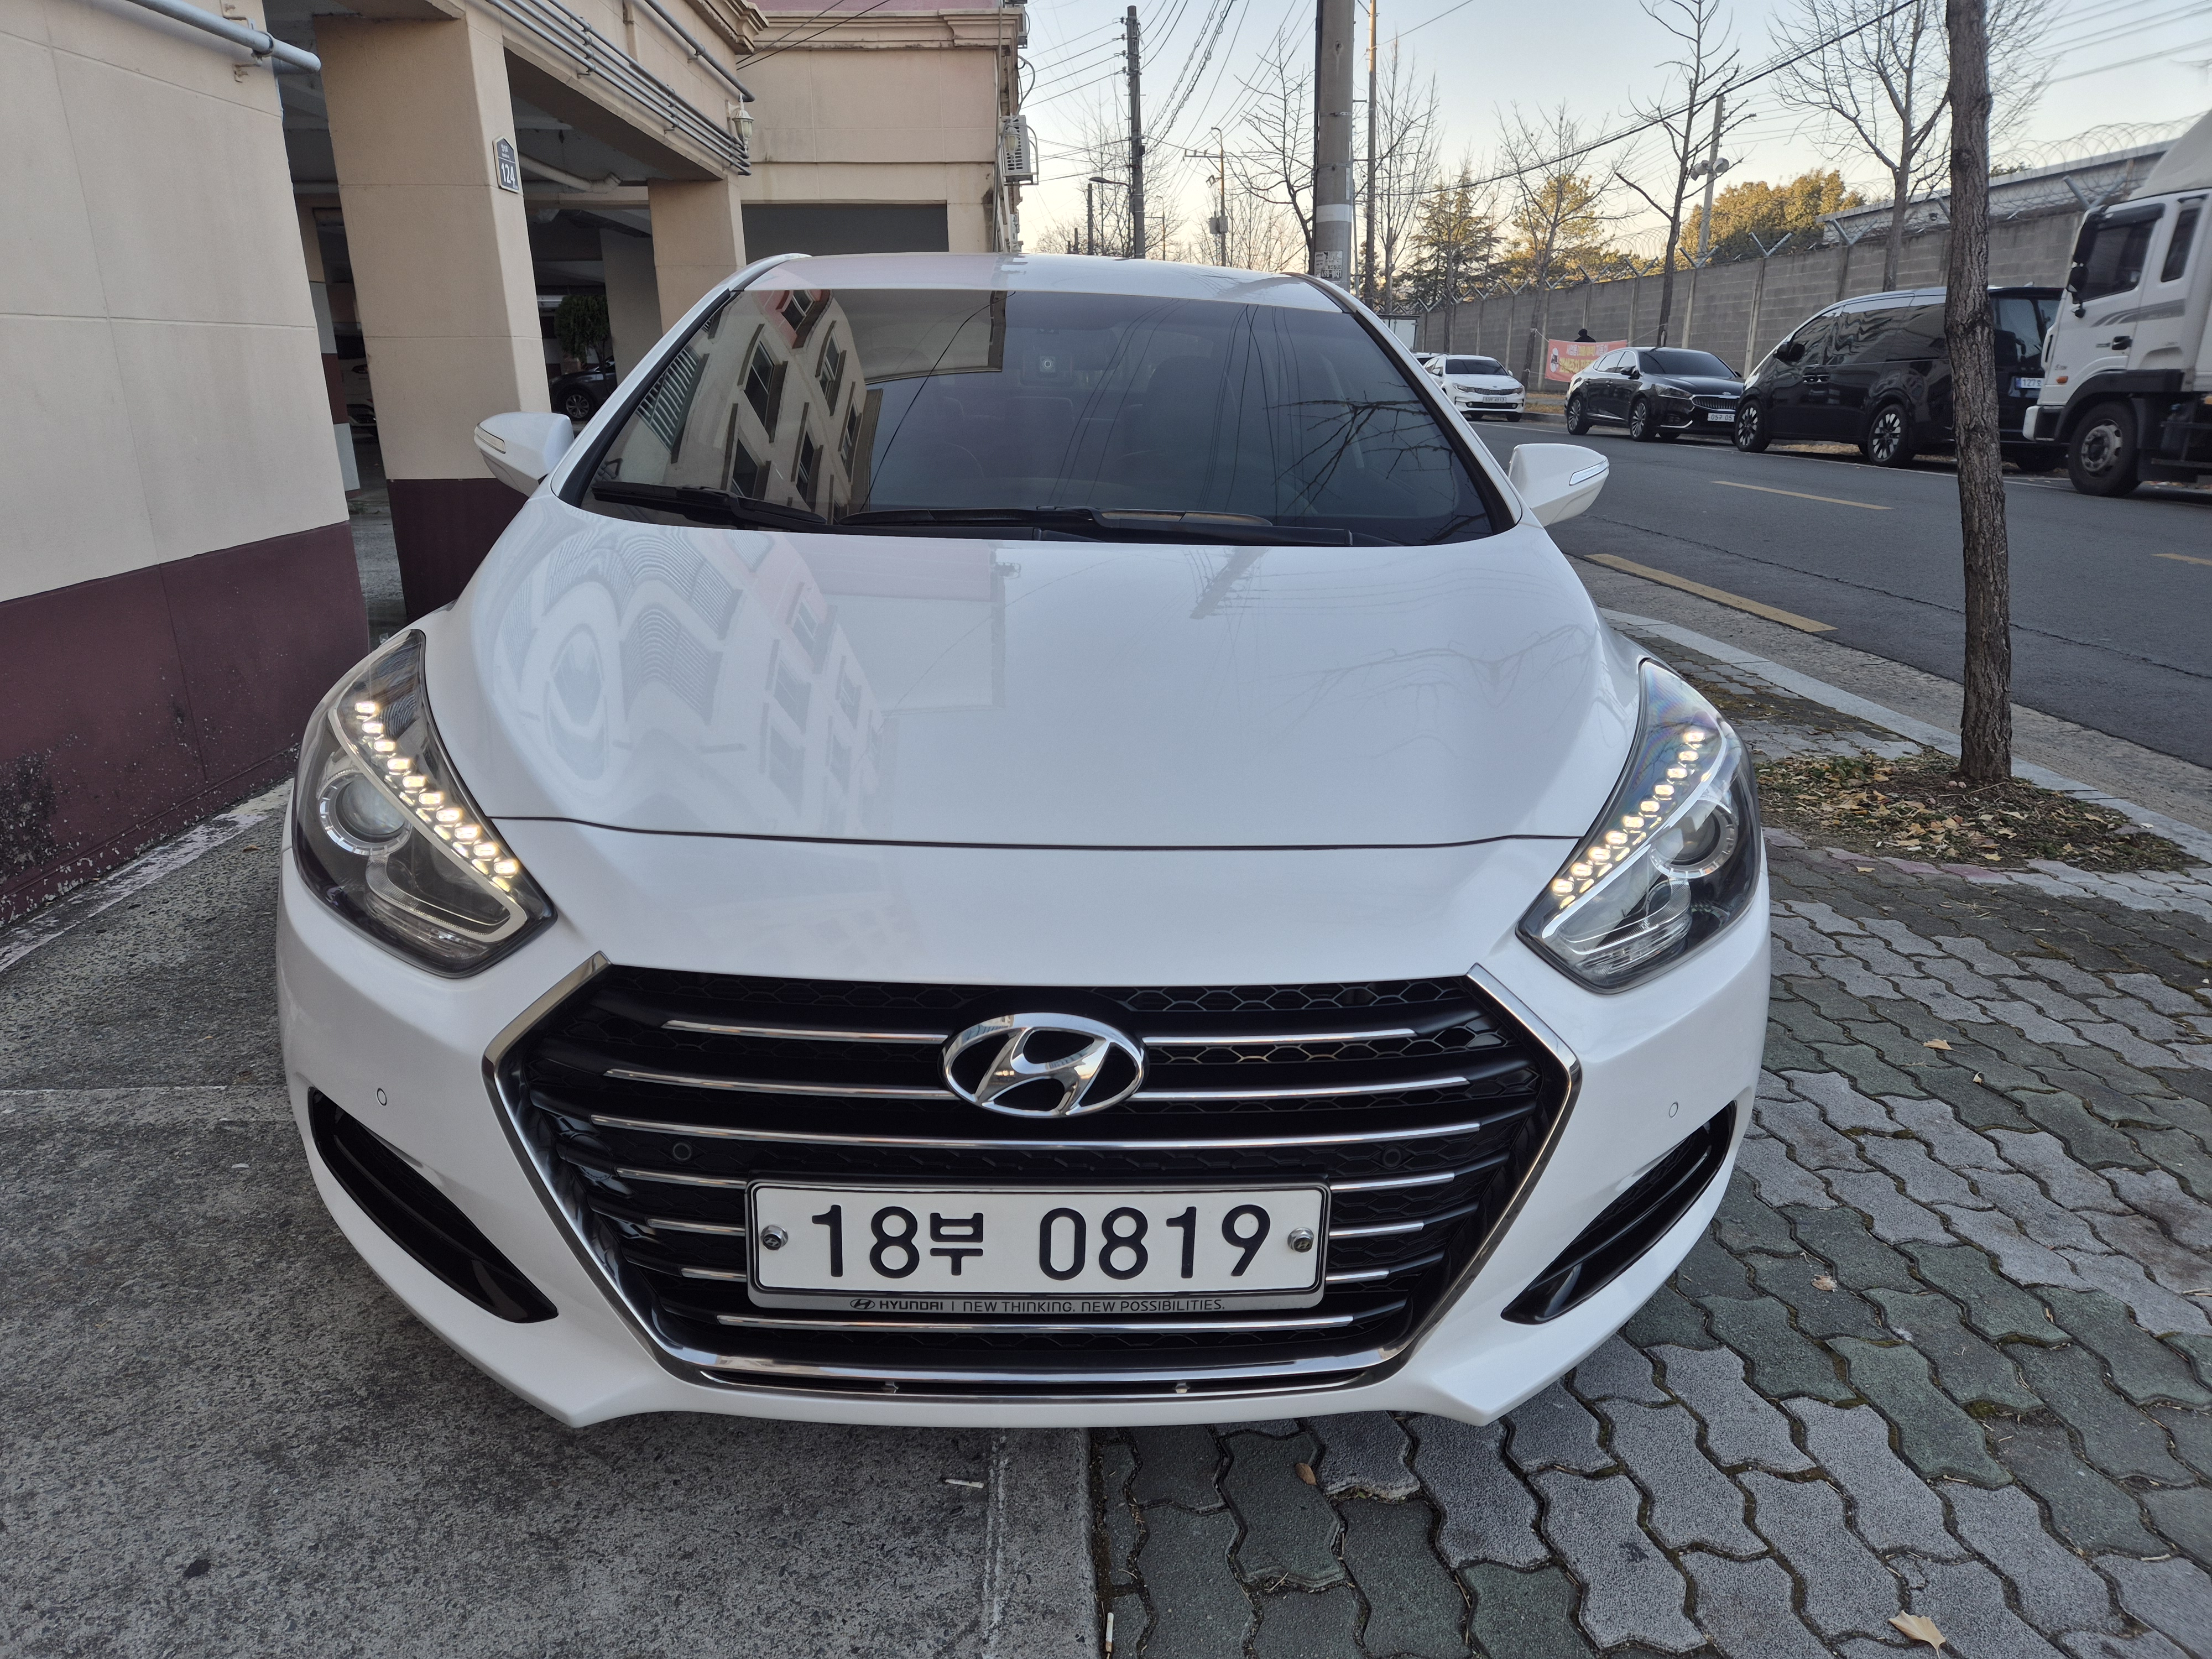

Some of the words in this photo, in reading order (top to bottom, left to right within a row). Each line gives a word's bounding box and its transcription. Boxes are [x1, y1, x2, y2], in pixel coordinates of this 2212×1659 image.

[501, 163, 515, 185] 124
[811, 1204, 984, 1279] 18부
[1039, 1203, 1271, 1280] 0819
[879, 1301, 943, 1311] HYUNDAI
[963, 1302, 997, 1312] NEW
[1002, 1301, 1076, 1312] THINKING.
[1081, 1301, 1115, 1312] NEW
[1120, 1300, 1225, 1312] POSSIBILITIES.
